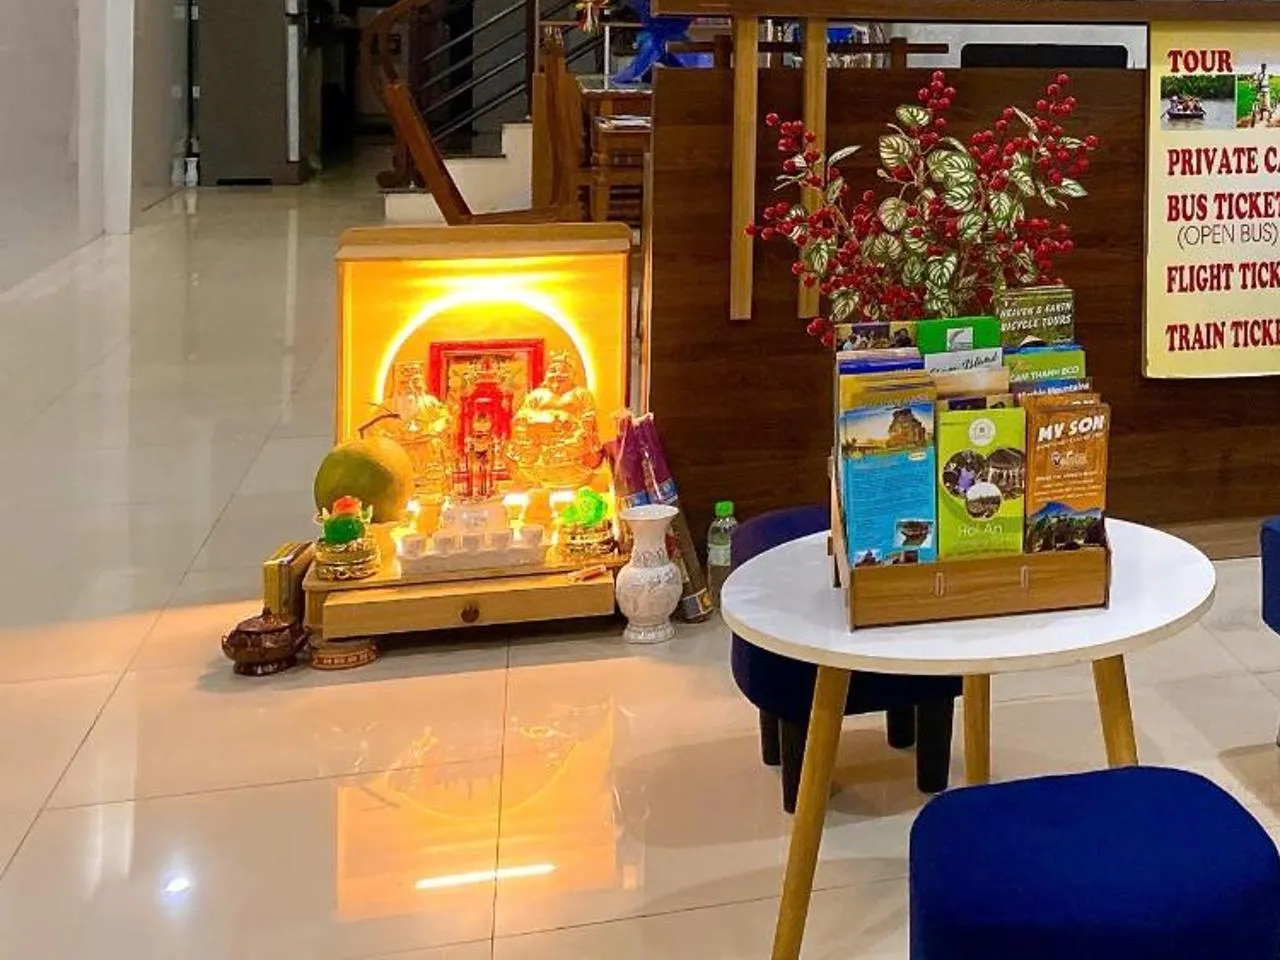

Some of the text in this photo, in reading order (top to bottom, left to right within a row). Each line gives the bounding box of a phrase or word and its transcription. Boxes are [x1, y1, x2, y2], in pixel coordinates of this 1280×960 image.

[1167, 49, 1233, 73] TOUR
[1167, 146, 1259, 176] PRIVATE
[1167, 193, 1208, 222] BUS
[1177, 221, 1279, 251] (OPEN BUS)
[1166, 262, 1234, 293] FLIGHT
[1165, 321, 1226, 351] TRAIN
[1061, 366, 1080, 376] ECO
[1038, 422, 1065, 442] MY
[1068, 415, 1105, 436] SON
